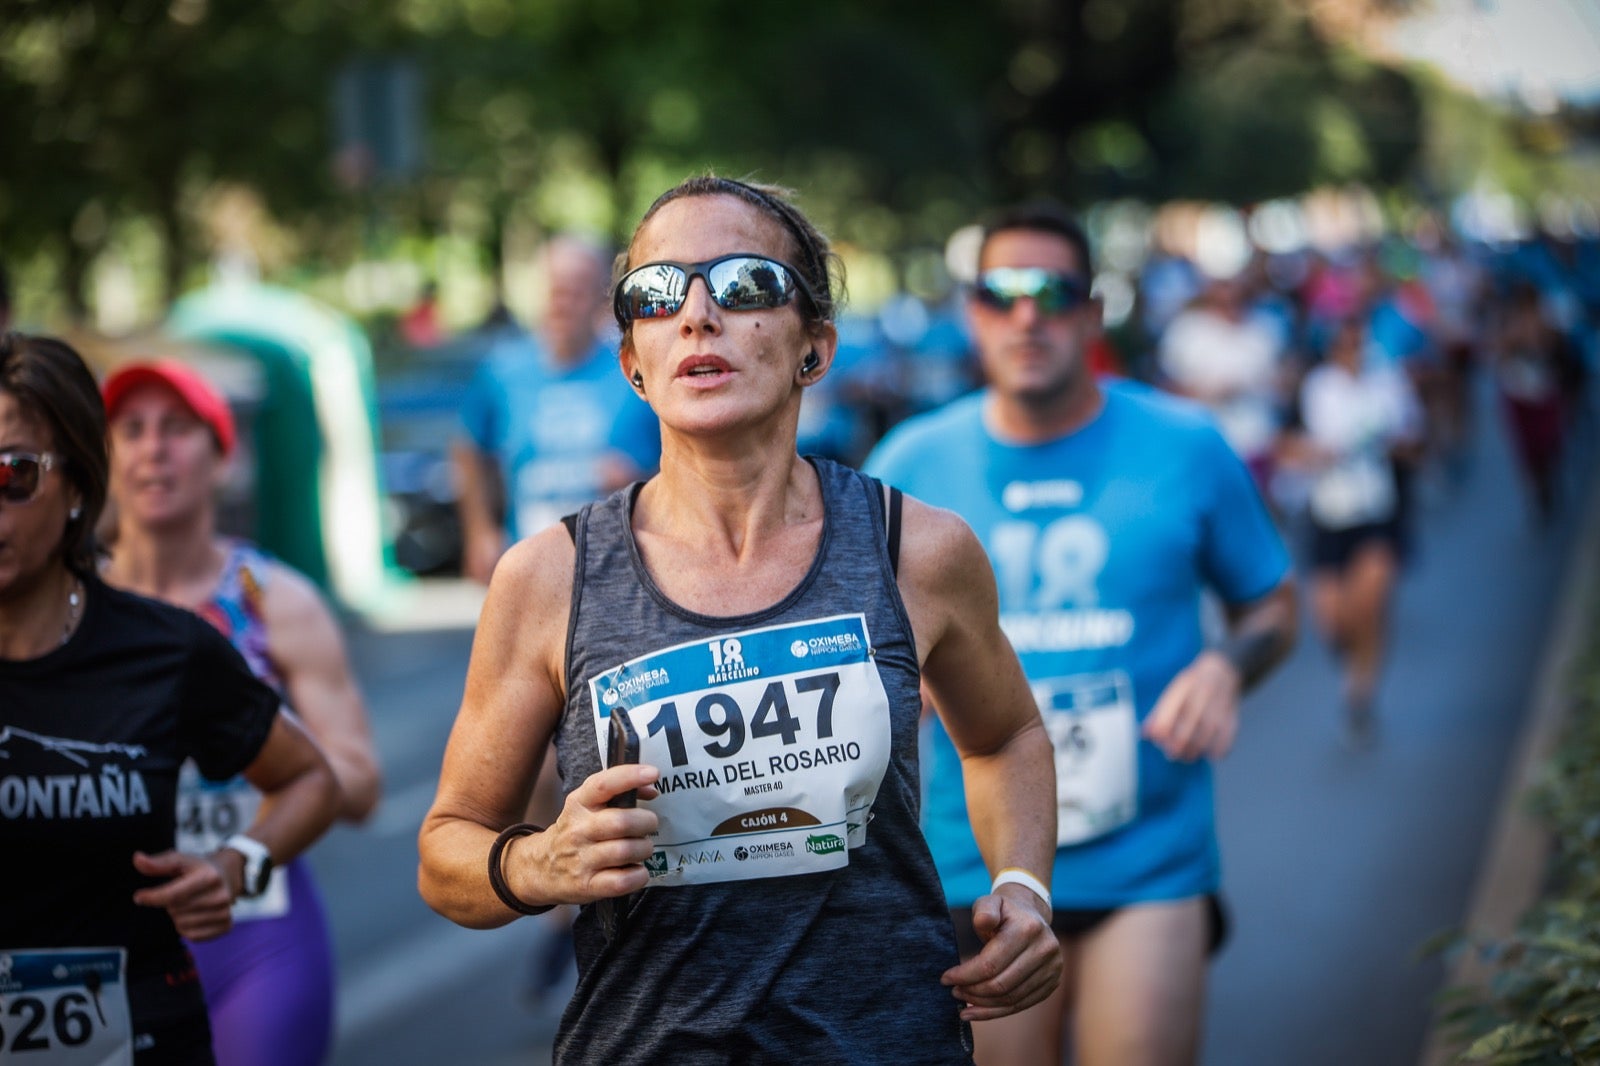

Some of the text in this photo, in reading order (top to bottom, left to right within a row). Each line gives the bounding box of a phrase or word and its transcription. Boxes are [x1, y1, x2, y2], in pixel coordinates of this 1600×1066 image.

[808, 632, 860, 648] OXIMESA
[708, 638, 744, 667] 18
[707, 666, 760, 685] MARCELINO
[714, 661, 745, 674] PADRE
[617, 667, 668, 692] OXIMESA
[646, 671, 841, 768] 1947
[653, 741, 861, 795] MARIA DEL ROSARIO
[743, 780, 783, 797] MASTER 40
[740, 811, 788, 829] CAJÓN 4
[749, 841, 794, 854] OXIMESA
[805, 837, 845, 853] Natura
[678, 849, 726, 867] ANAYA
[0, 992, 94, 1055] 26
